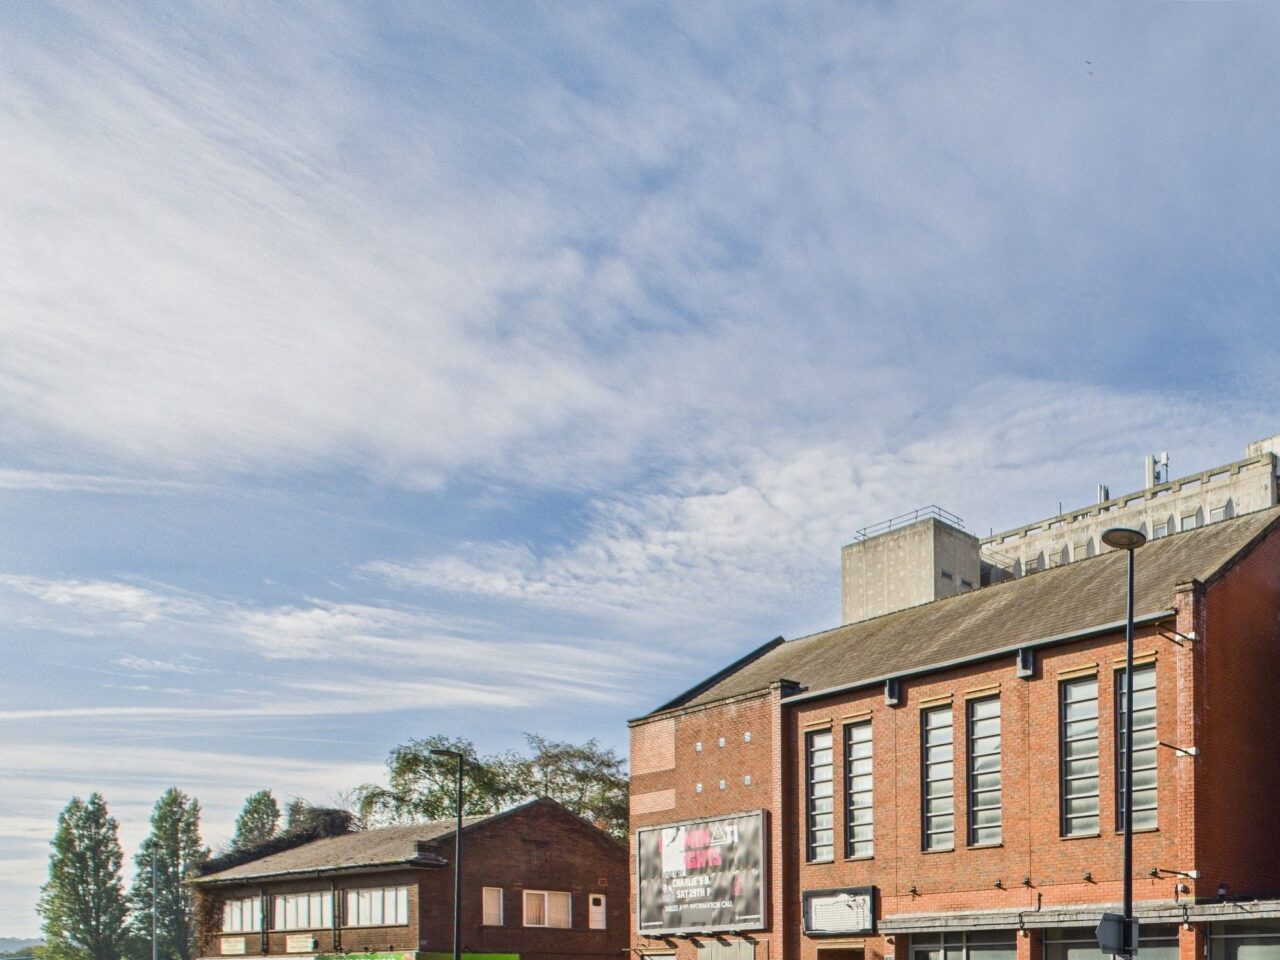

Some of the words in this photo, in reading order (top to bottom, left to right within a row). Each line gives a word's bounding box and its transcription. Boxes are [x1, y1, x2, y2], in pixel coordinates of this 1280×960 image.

[672, 876, 704, 888] CHARLIE'S
[677, 889, 688, 899] SAT
[688, 887, 705, 898] 29TH
[689, 901, 721, 910] INFORMATION
[721, 900, 733, 908] CALL
